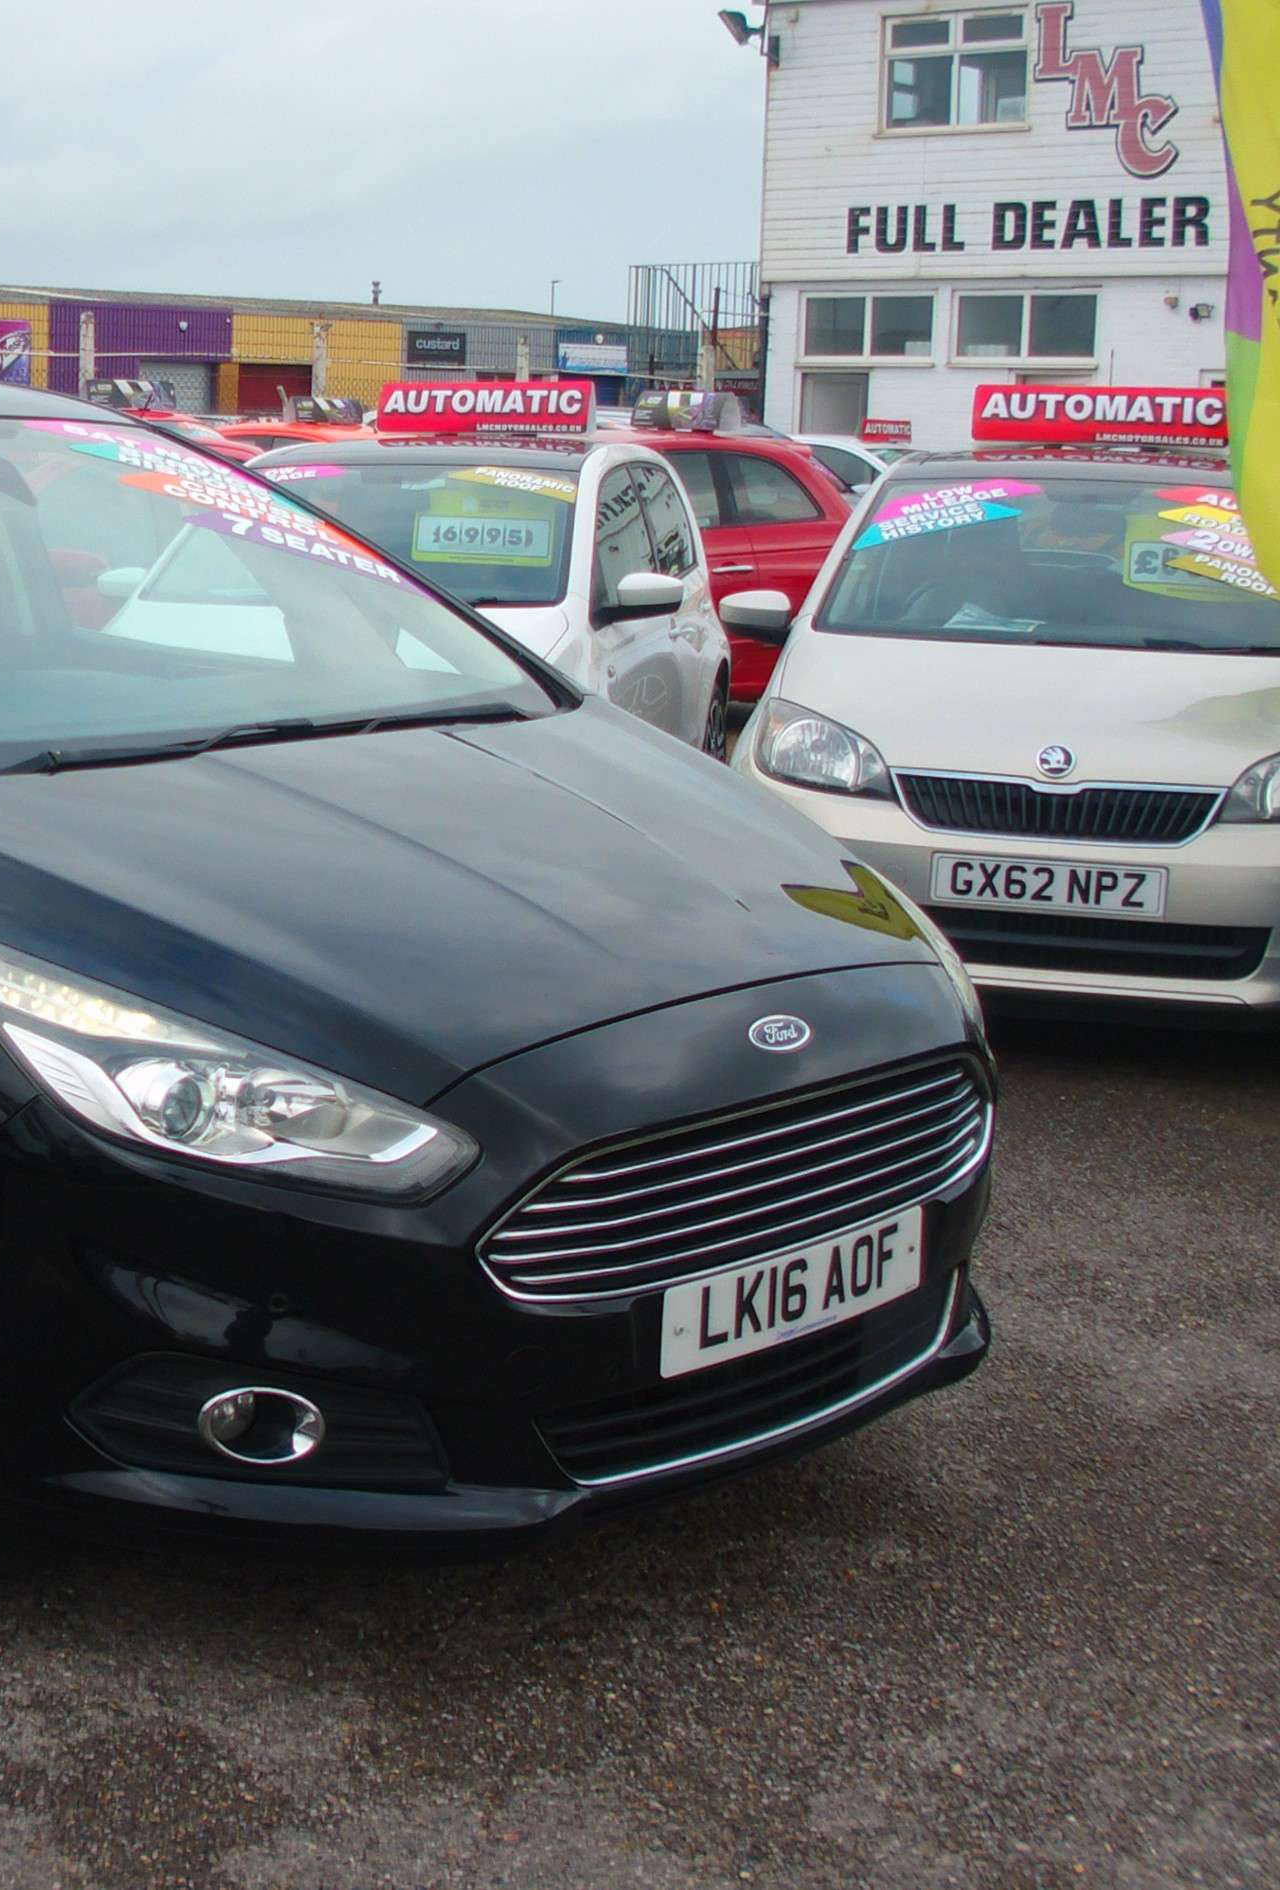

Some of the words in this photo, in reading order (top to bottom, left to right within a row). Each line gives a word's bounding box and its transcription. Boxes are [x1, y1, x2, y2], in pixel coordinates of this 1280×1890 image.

[1034, 2, 1179, 179] LMC
[846, 205, 966, 254] FULL
[991, 196, 1212, 251] DEALER
[415, 338, 460, 351] custard
[383, 389, 582, 415] AUTOMATIC
[981, 393, 1224, 426] AUTOMATIC
[1095, 433, 1224, 446] LMCMOTORSALES.CO.UK
[475, 466, 575, 493] PANORAMIC
[494, 478, 544, 491] ROOF
[921, 484, 973, 502] LOW
[163, 484, 340, 544] CONTROL
[900, 487, 1009, 516] MILEAGE
[878, 502, 982, 531] SERVICE
[880, 510, 986, 541] HISTORY
[222, 512, 254, 536] 7
[262, 527, 401, 584] SEATER
[950, 860, 1055, 902] GX62
[1066, 869, 1147, 909] NPZ
[763, 1022, 798, 1043] Ford
[699, 1257, 808, 1350] LK16
[821, 1222, 899, 1311] AOF
